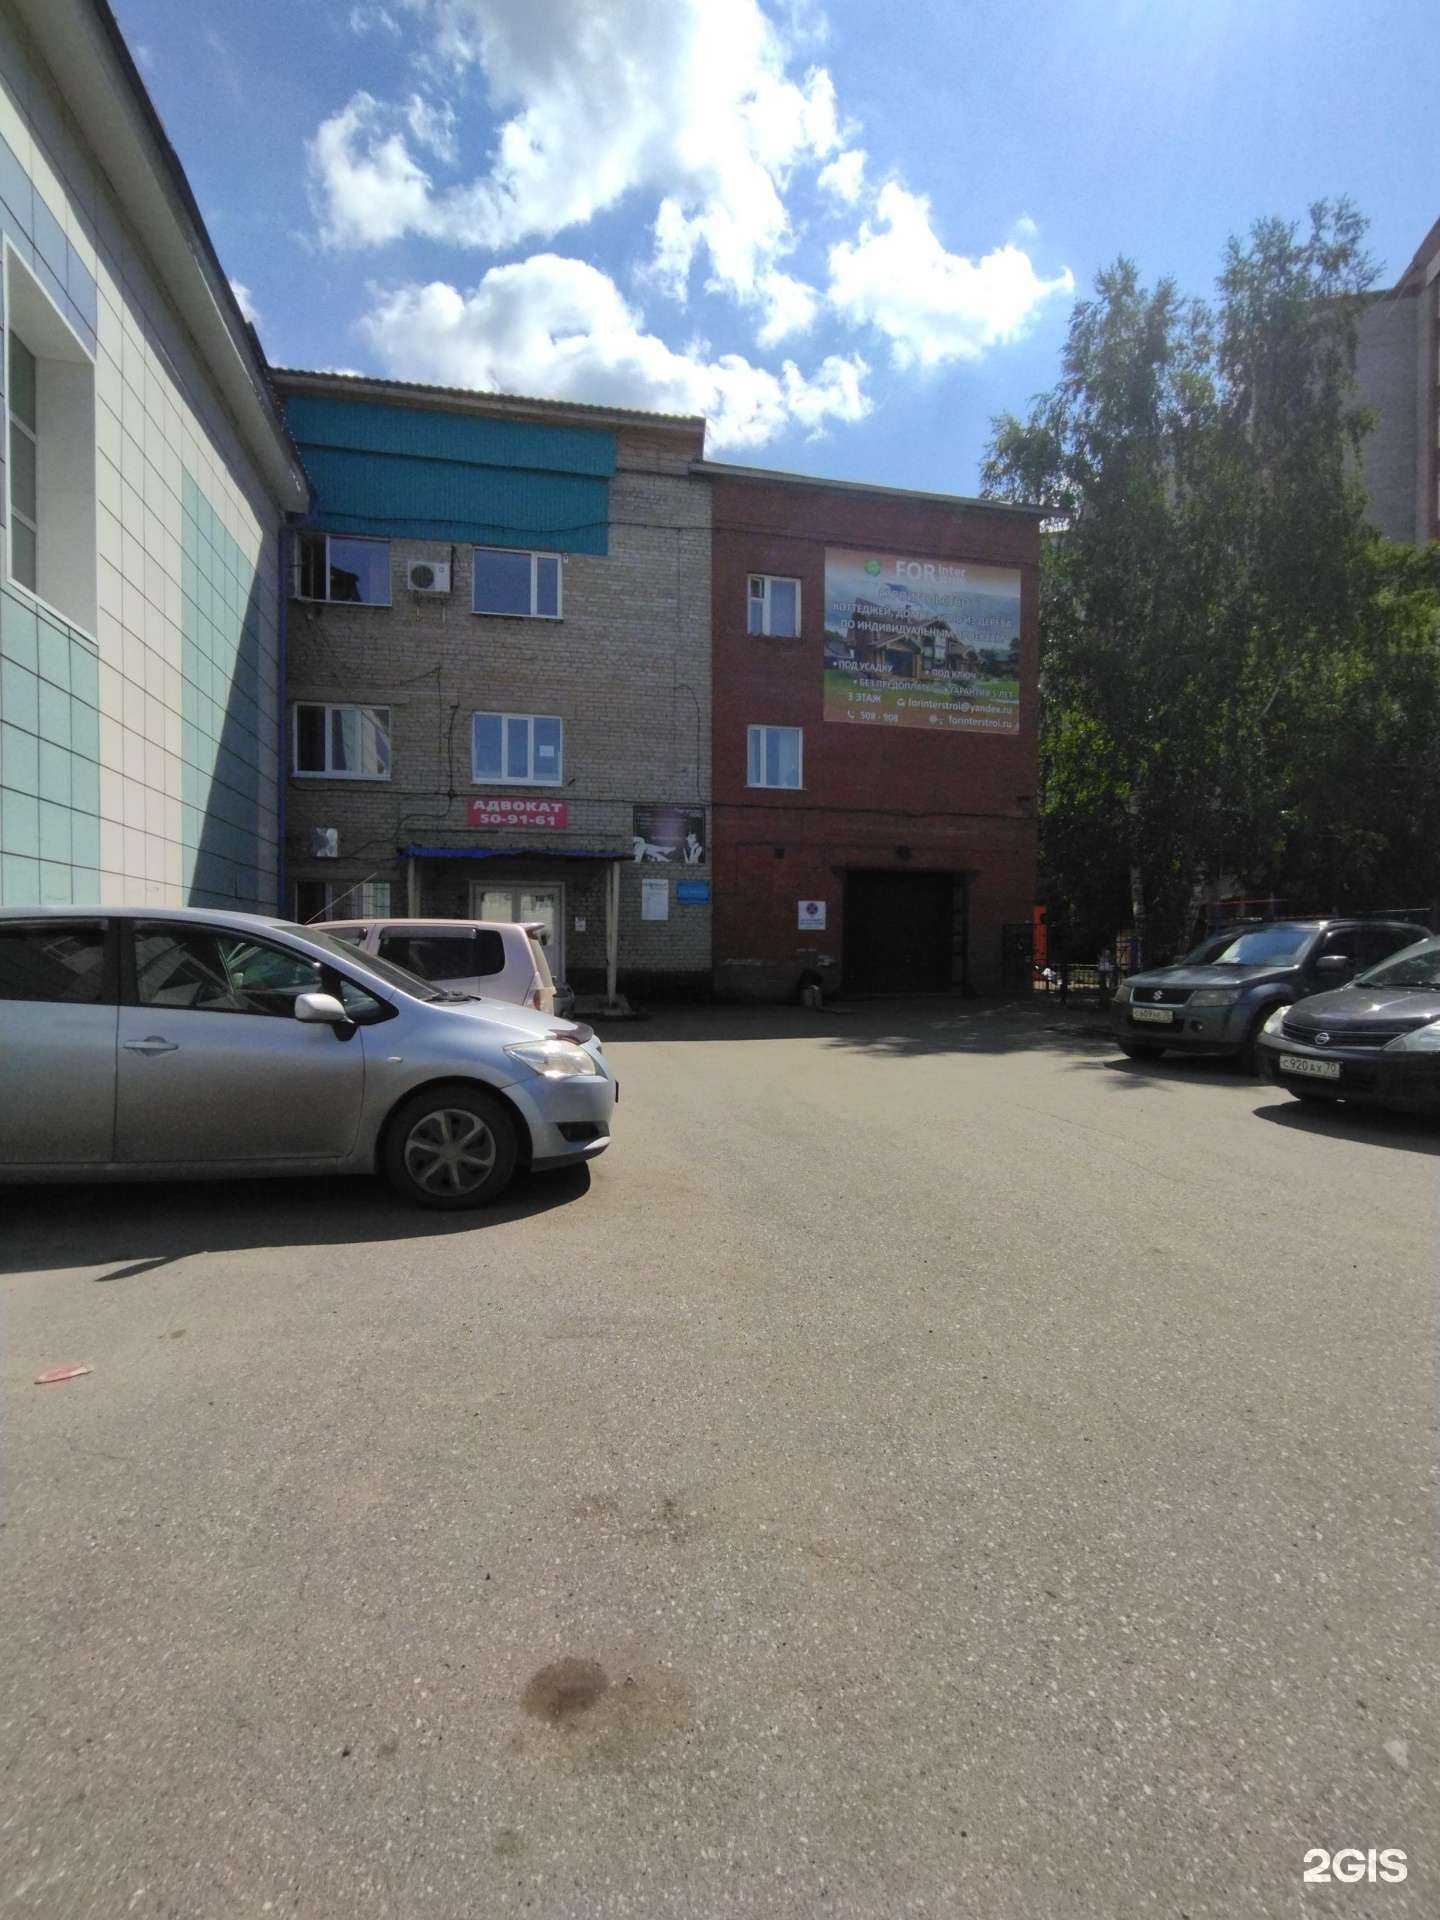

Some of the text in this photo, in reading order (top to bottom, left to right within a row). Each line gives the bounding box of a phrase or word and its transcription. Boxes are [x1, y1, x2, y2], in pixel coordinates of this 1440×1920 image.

[896, 560, 936, 582] FOR
[840, 618, 855, 630] ПО
[473, 800, 563, 813] АДВОКАТ
[480, 813, 556, 826] 50-91-61
